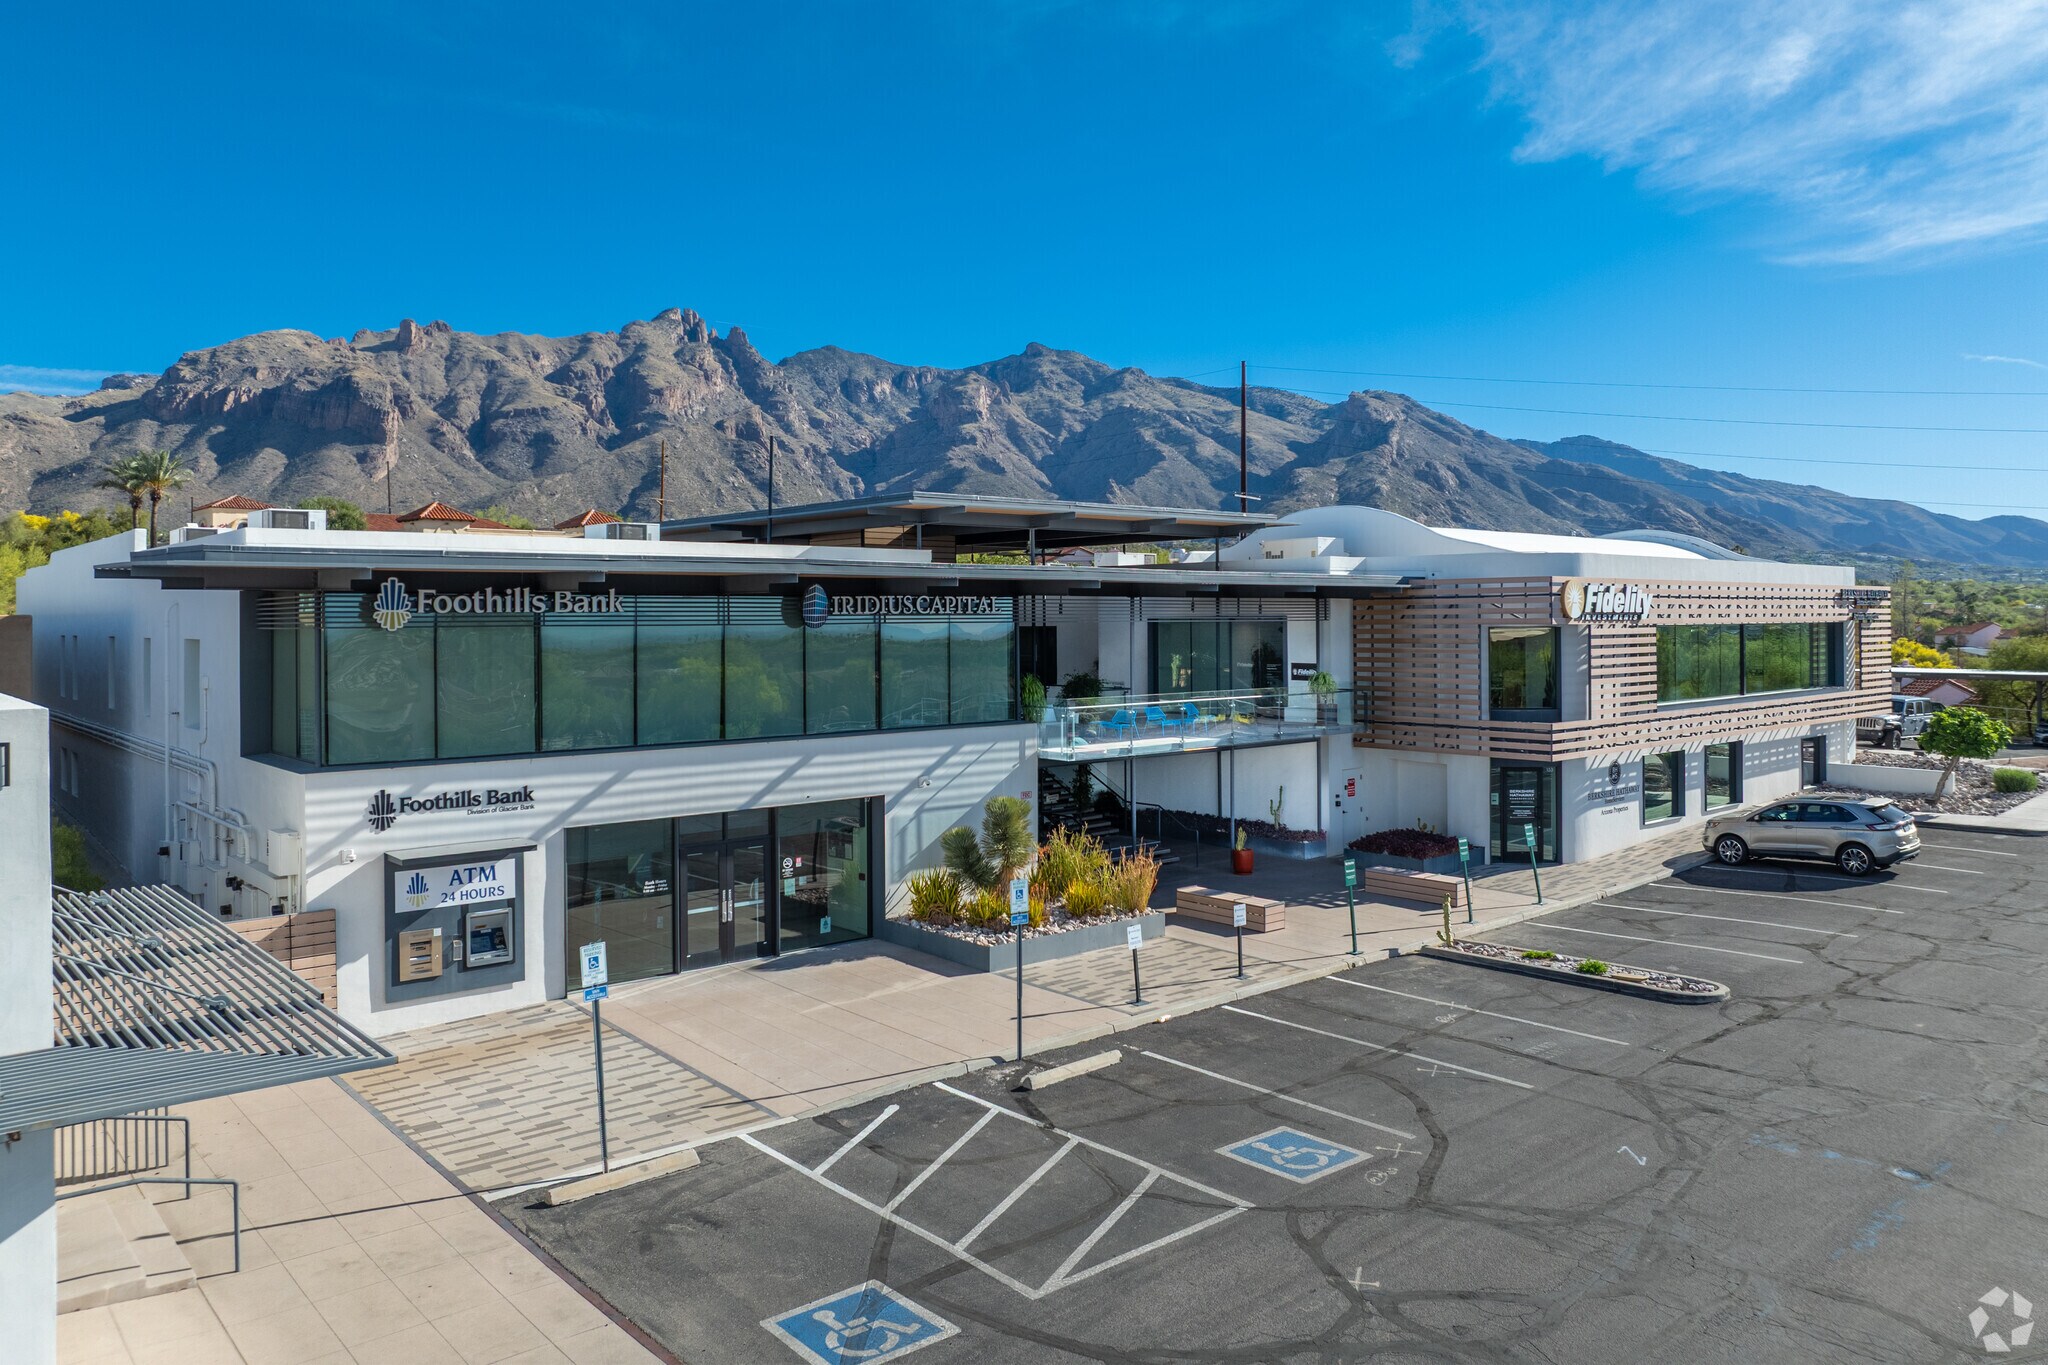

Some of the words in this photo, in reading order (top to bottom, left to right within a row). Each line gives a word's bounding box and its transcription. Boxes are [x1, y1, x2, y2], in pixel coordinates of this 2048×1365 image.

[417, 587, 547, 613] Foothills
[554, 588, 624, 613] Bank
[1584, 583, 1653, 619] Fidelity
[399, 790, 481, 813] Foothills
[487, 785, 534, 806] Bank
[1587, 789, 1615, 801] BERKSHIRE
[1615, 785, 1640, 797] HATHAWAY
[467, 808, 490, 816] Division
[499, 805, 519, 813] Glacier
[449, 865, 497, 886] ATM
[441, 892, 456, 903] 24
[460, 885, 505, 901] HOURS
